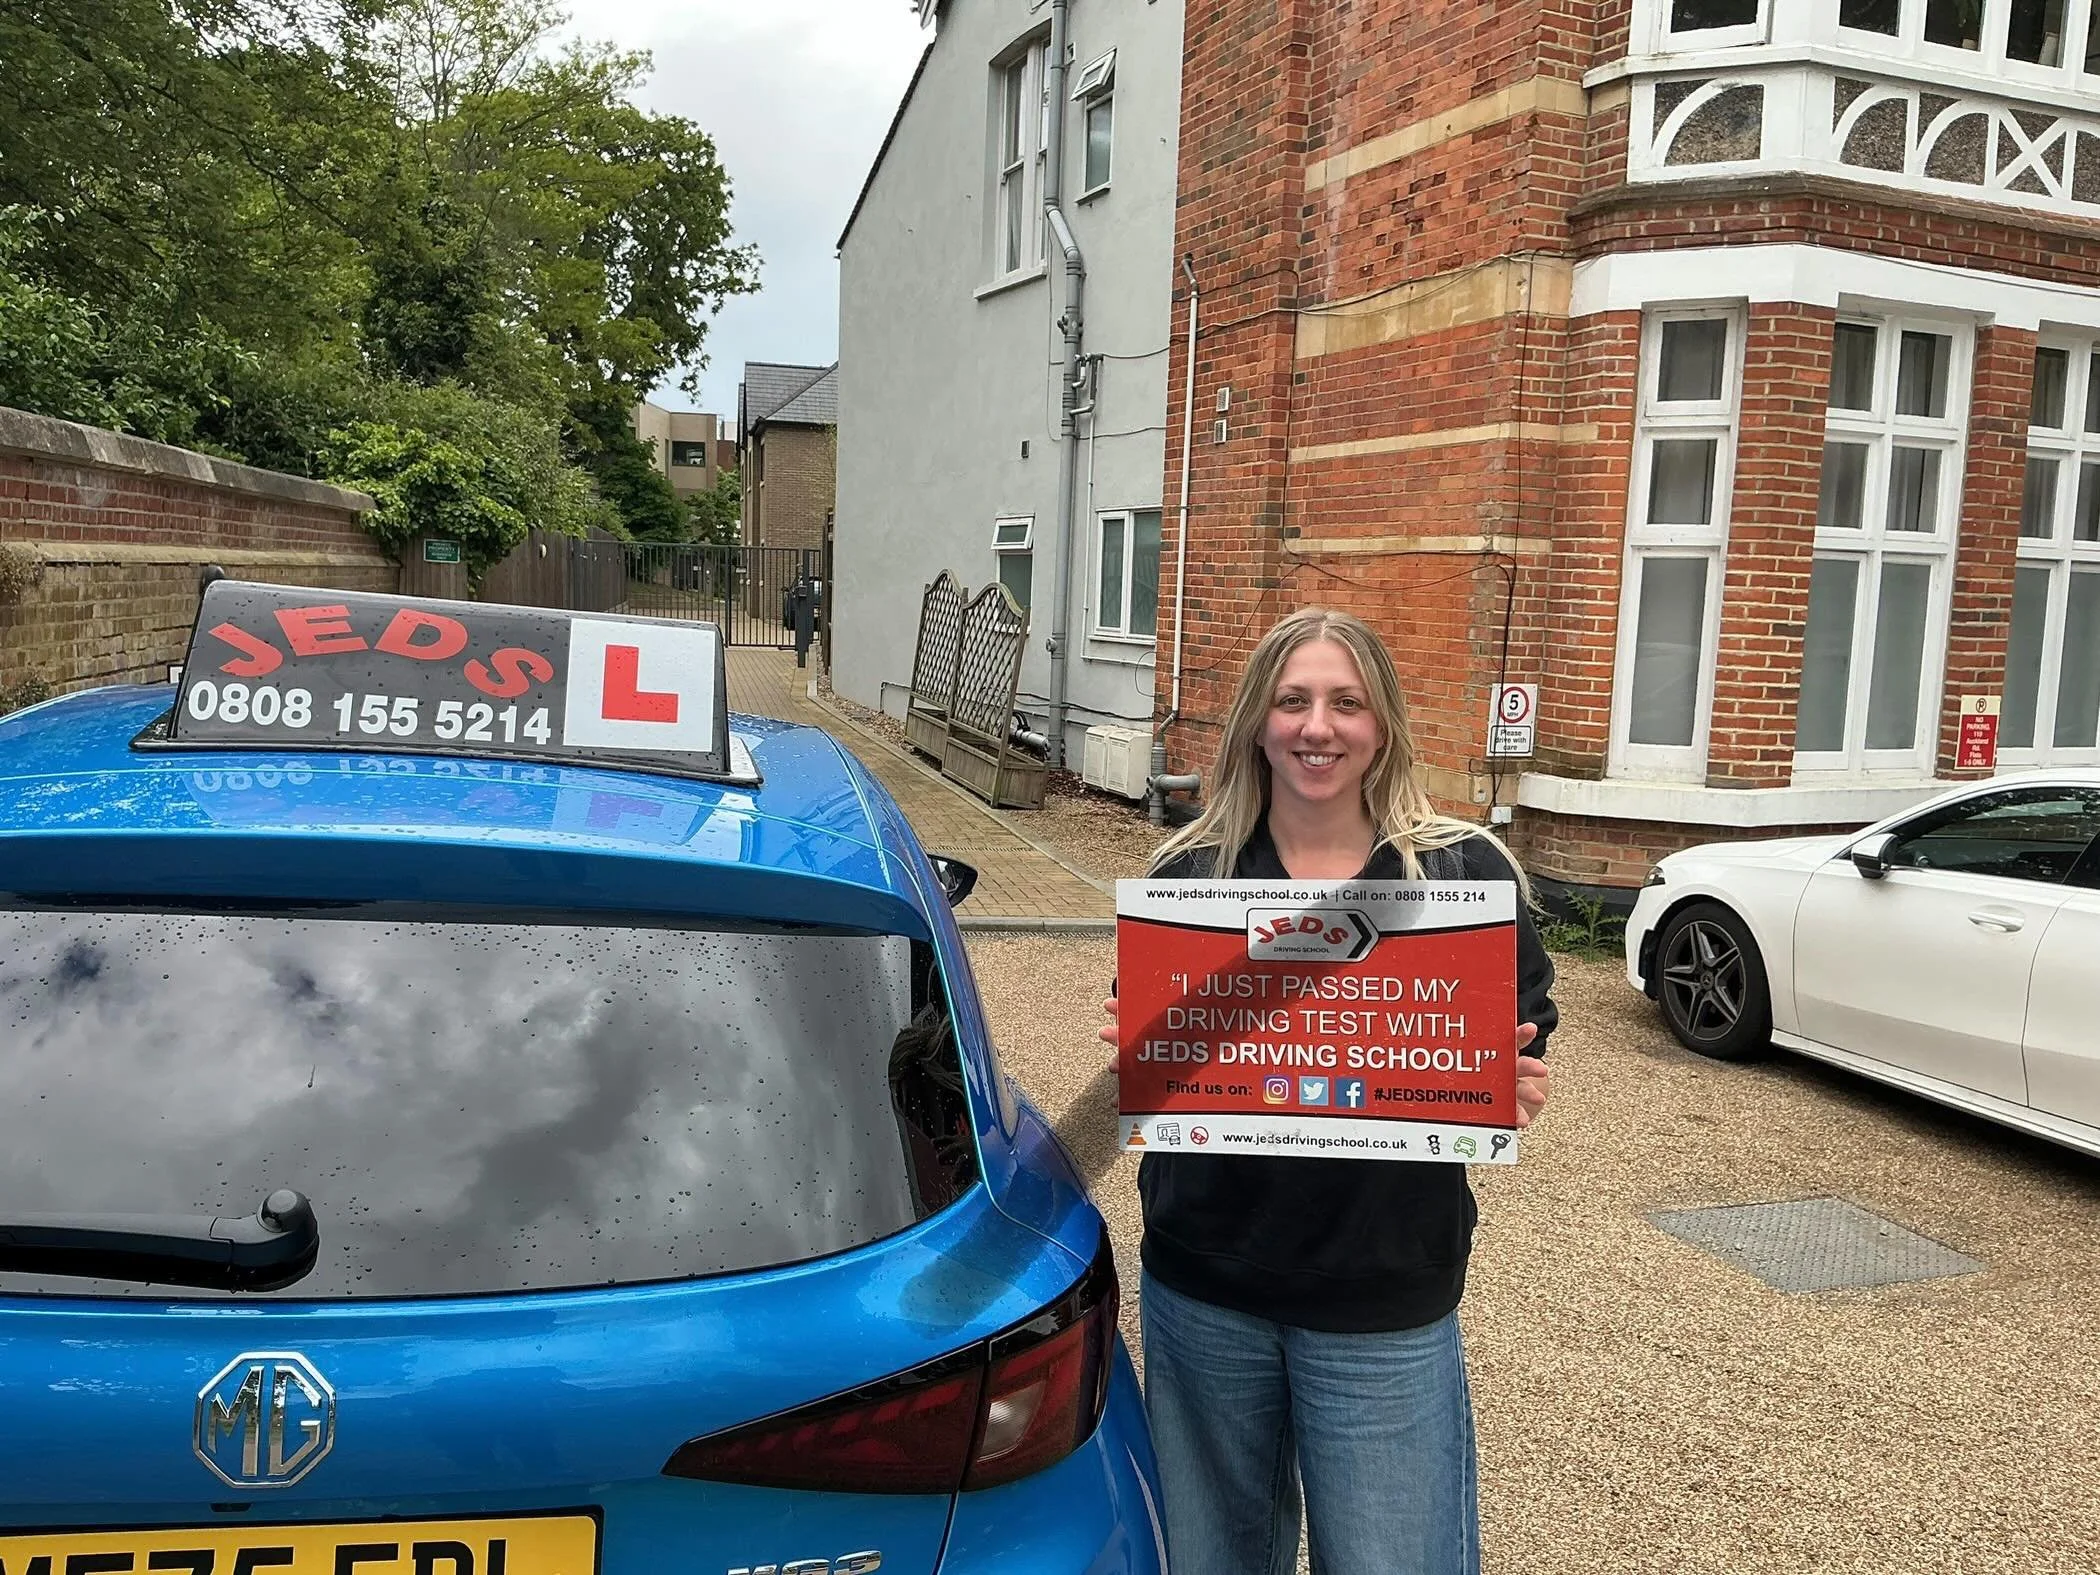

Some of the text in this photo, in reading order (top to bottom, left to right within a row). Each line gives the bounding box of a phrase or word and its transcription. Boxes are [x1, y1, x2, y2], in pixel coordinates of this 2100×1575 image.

[208, 604, 554, 699] JEDS
[601, 643, 679, 723] L
[187, 680, 551, 745] 0808 155 5214
[1508, 694, 1519, 710] 5
[1146, 888, 1486, 902] www.jedsdrivingschool.co.uk Call on: 0808 1555 214
[1254, 916, 1349, 945] JEDS
[1198, 973, 1273, 998] JUST
[1282, 975, 1403, 1001] PASSED
[1414, 978, 1460, 1003] MY
[1167, 1007, 1466, 1038] DRIVING TEST WITH
[1136, 1040, 1210, 1064] JEDS
[1219, 1042, 1338, 1068] DRIVING
[1166, 1080, 1200, 1094] Find
[1204, 1085, 1223, 1095] us
[1228, 1085, 1252, 1096] on:
[1374, 1088, 1493, 1105] #JEDSDRIVING
[1222, 1133, 1408, 1150] www.jedsdrivingschool.co.uk
[207, 1365, 322, 1477] MG
